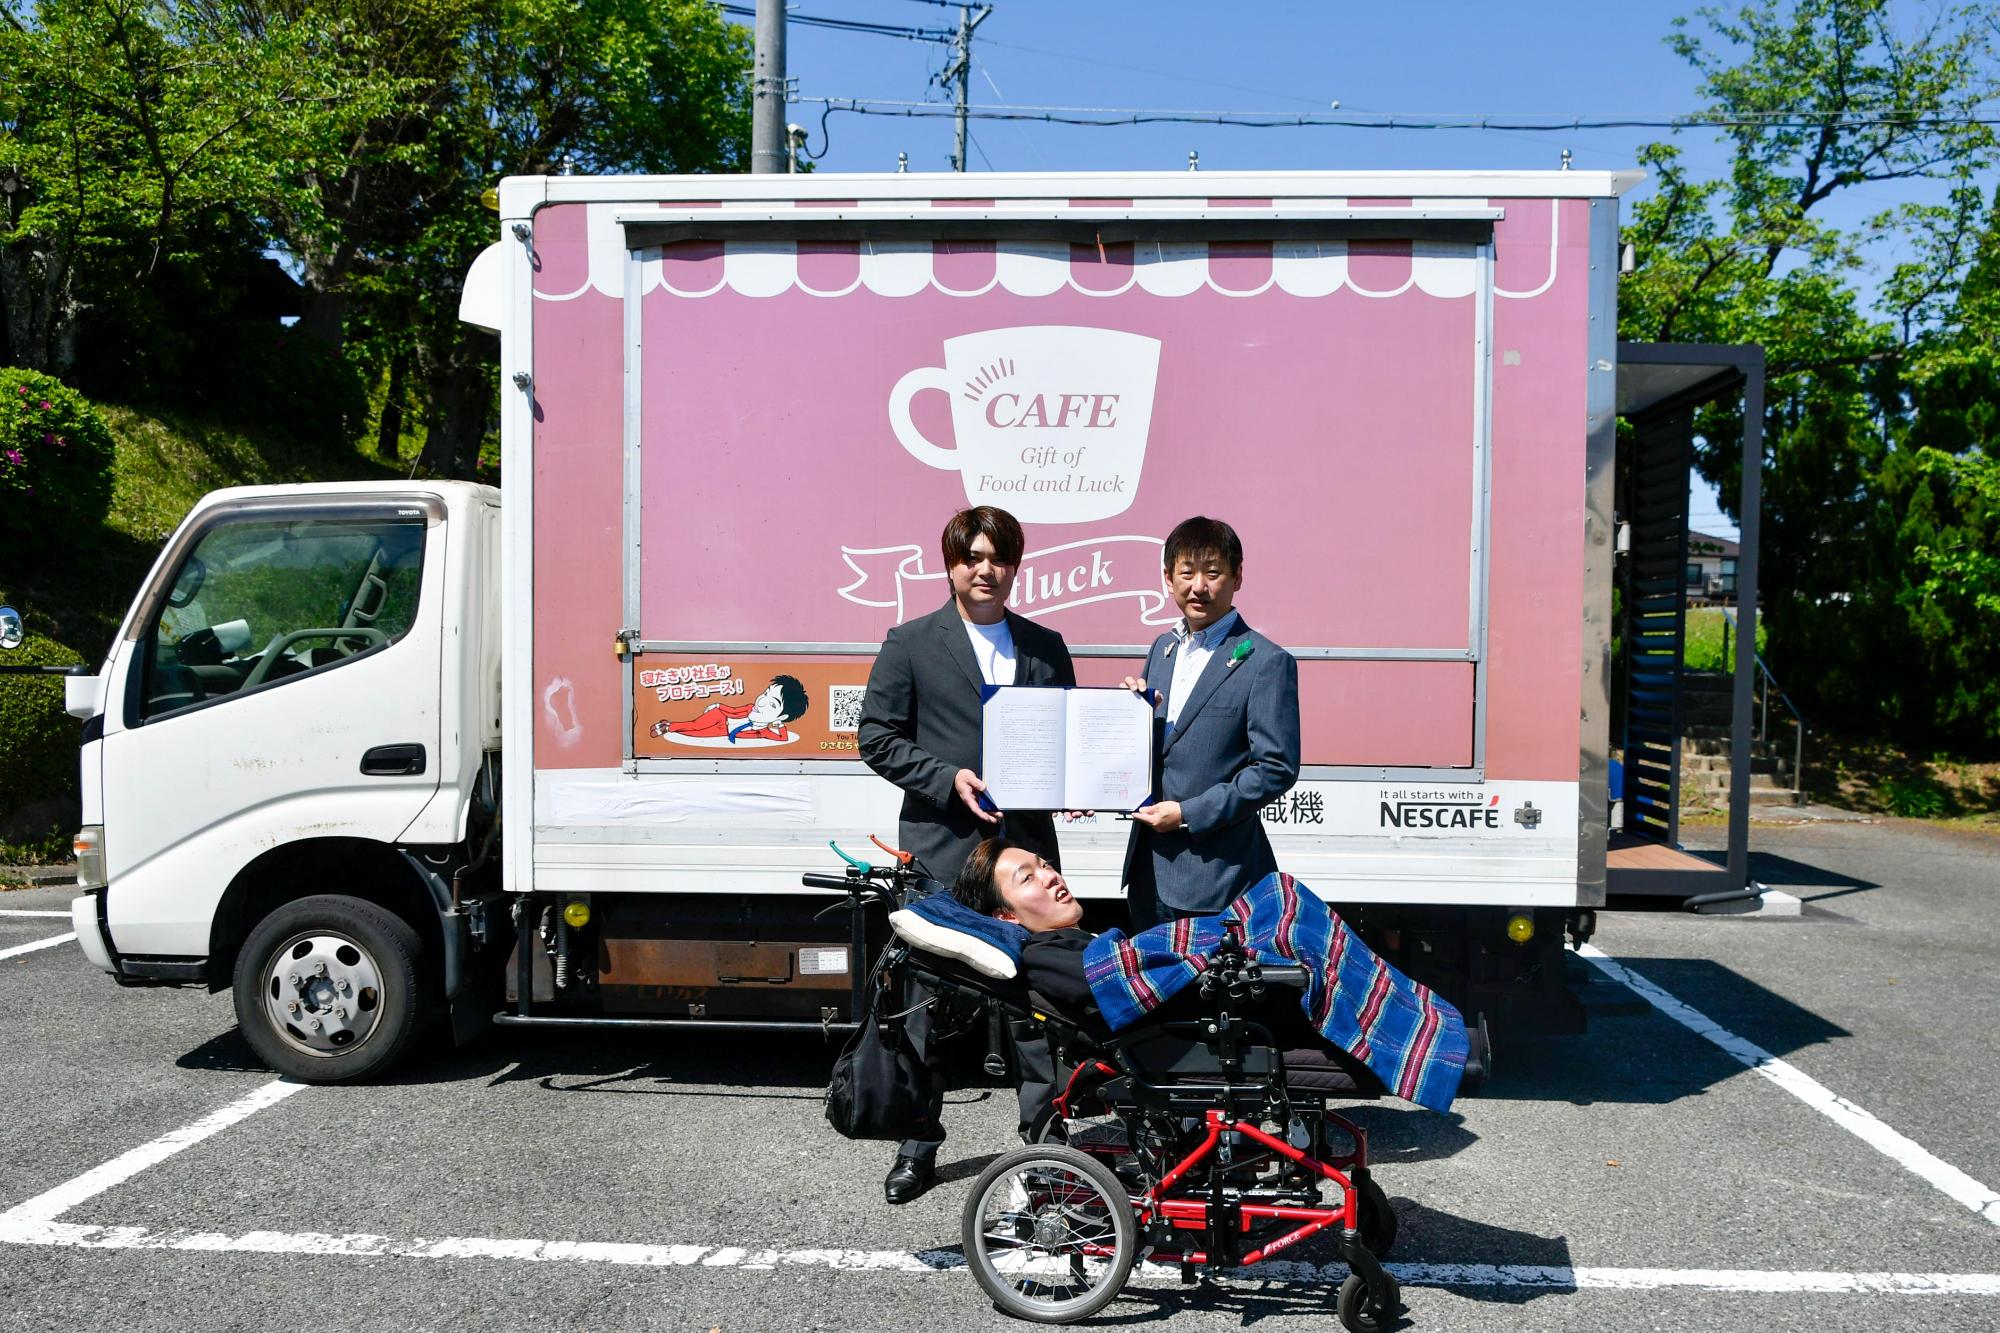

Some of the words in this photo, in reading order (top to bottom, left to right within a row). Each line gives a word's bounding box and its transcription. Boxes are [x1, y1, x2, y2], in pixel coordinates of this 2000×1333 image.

[985, 393, 1120, 428] CAFE
[1020, 446, 1058, 468] Gift
[1063, 446, 1087, 468] of
[977, 474, 1028, 492] Food
[1032, 474, 1072, 492] and
[1076, 474, 1125, 493] Luck
[640, 664, 731, 687] 寝たきり社長が
[1380, 790, 1389, 799] It
[1392, 790, 1407, 799] all
[1410, 790, 1445, 799] starts
[1448, 790, 1474, 800] with
[1477, 792, 1484, 800] a
